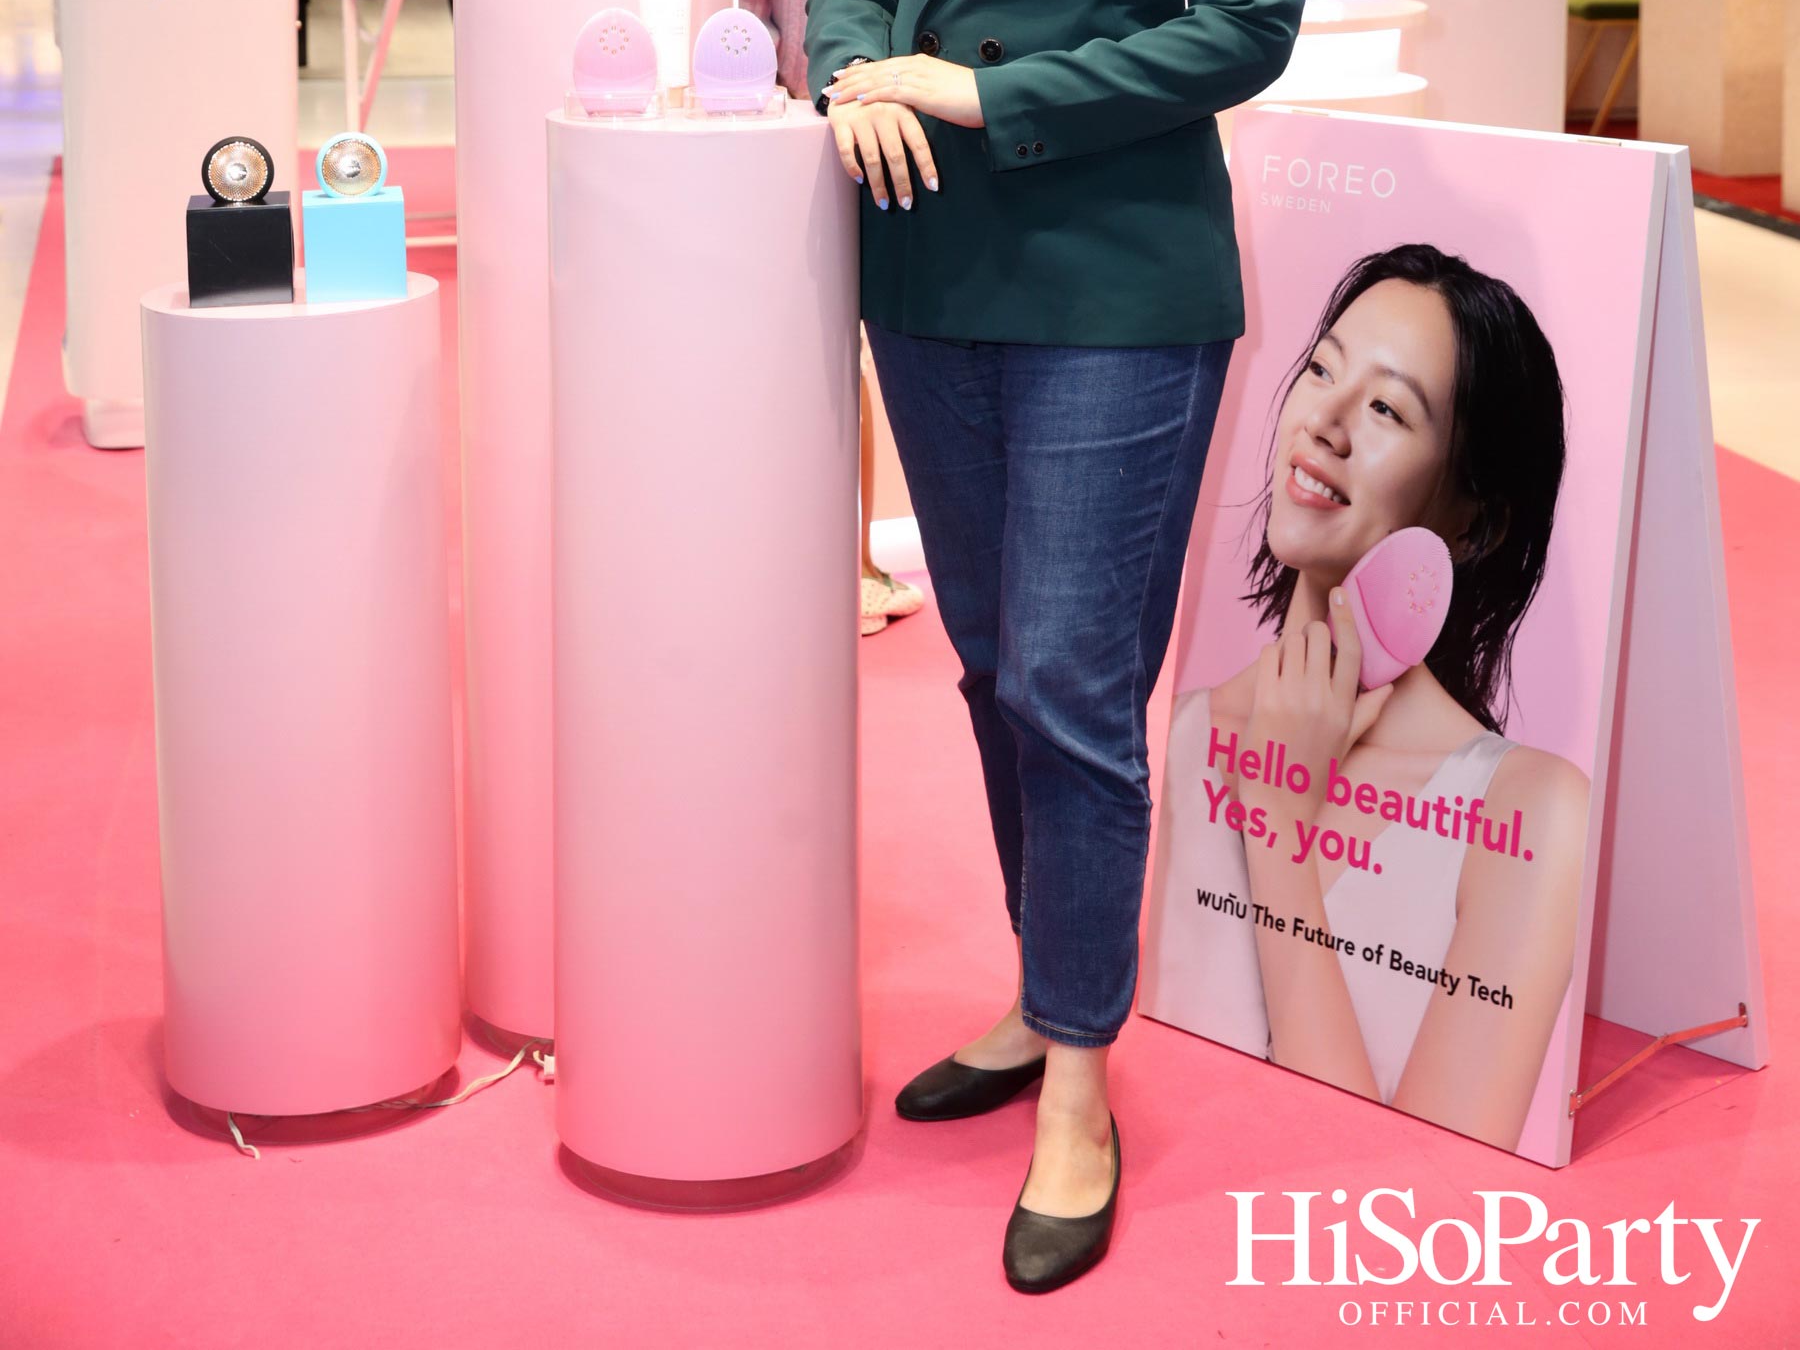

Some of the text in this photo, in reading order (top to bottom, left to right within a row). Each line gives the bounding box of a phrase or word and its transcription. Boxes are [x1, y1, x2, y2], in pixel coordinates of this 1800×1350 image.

[1260, 191, 1332, 213] SWEDEN
[1262, 154, 1396, 198] FOREO
[1202, 779, 1383, 875] Yes, you.
[1207, 727, 1534, 862] Hello beautiful.
[1196, 887, 1514, 1009] พบกับ The Future of Beauty Tech
